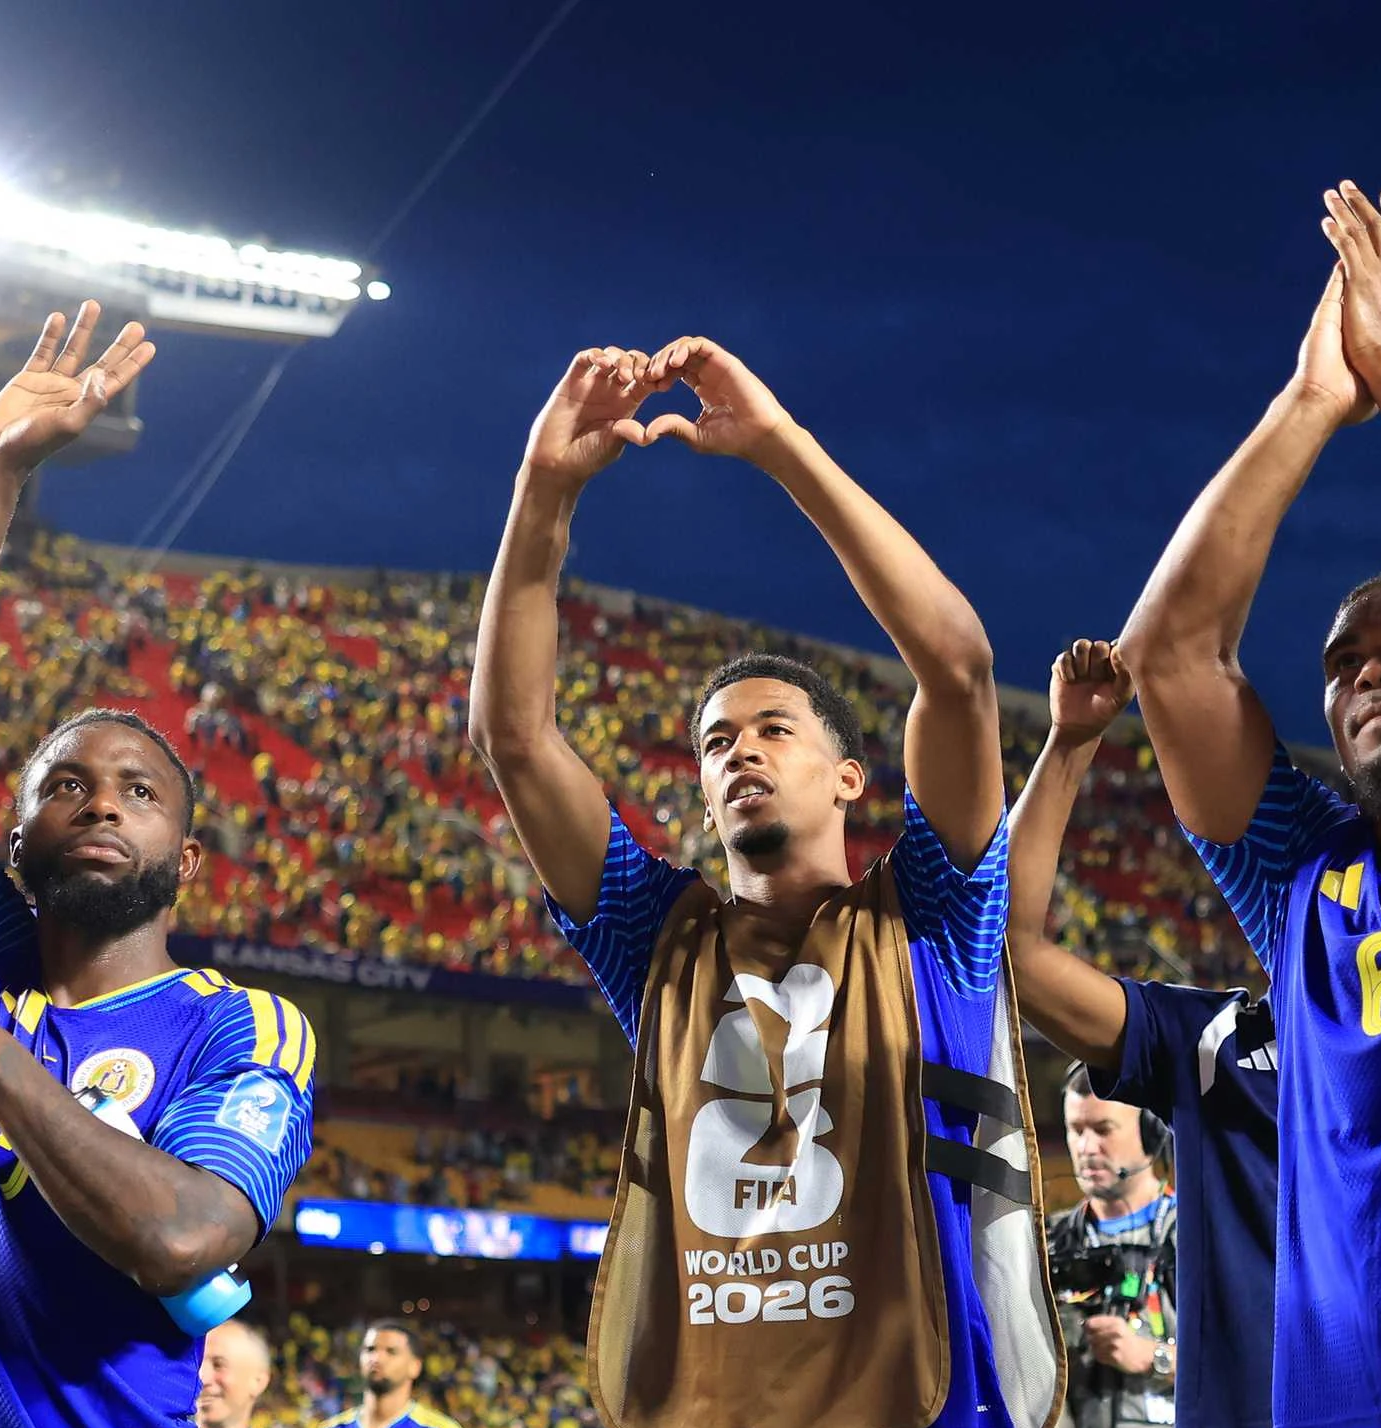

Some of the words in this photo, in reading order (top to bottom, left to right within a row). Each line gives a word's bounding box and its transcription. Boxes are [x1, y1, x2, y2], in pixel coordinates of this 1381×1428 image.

[685, 1249, 782, 1276] WORLD
[788, 1241, 848, 1271] CUP
[688, 1275, 855, 1325] 2026
